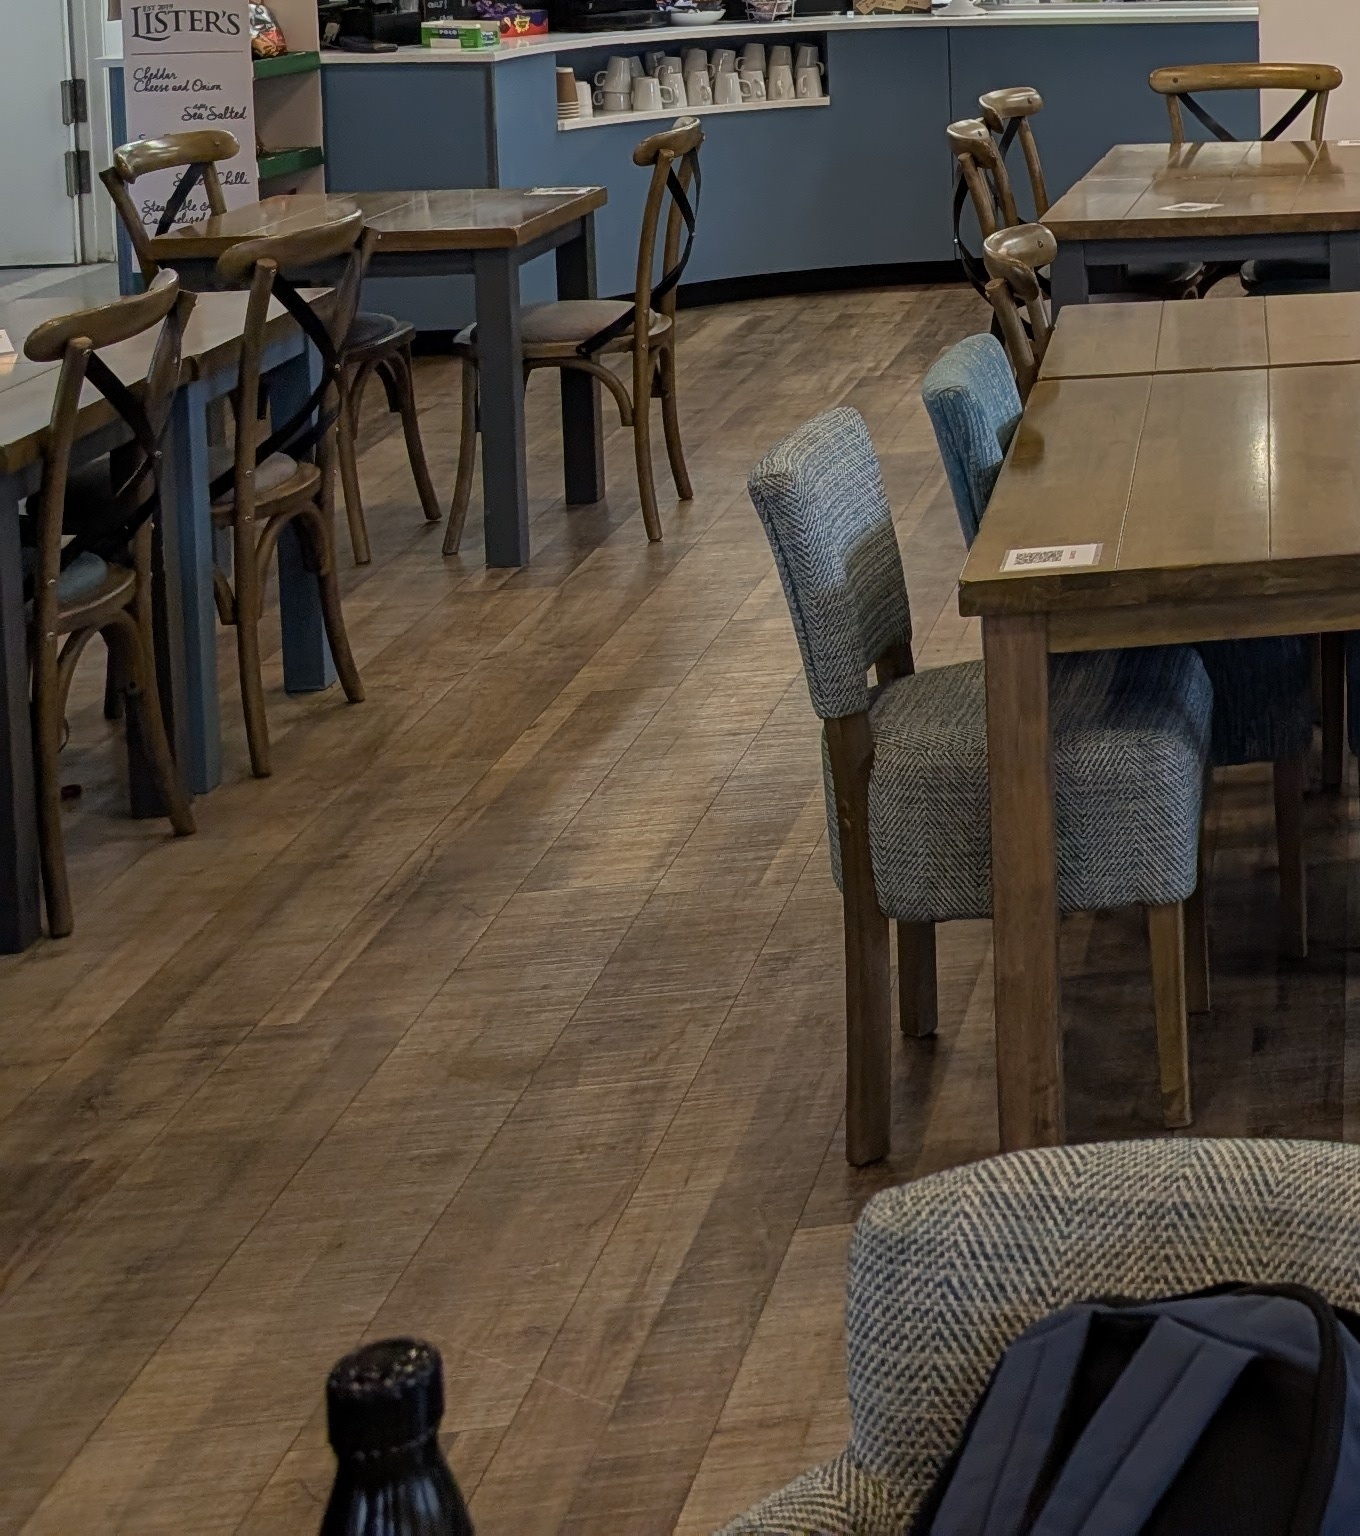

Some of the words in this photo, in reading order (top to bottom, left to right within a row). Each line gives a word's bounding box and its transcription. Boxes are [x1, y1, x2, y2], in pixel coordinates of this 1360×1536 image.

[130, 5, 241, 42] LISTER'S
[133, 67, 178, 81] Cheddar
[133, 79, 170, 93] Cheese
[172, 82, 190, 92] and
[192, 79, 223, 92] Onion
[181, 106, 204, 122] Sea
[207, 106, 247, 121] Salted
